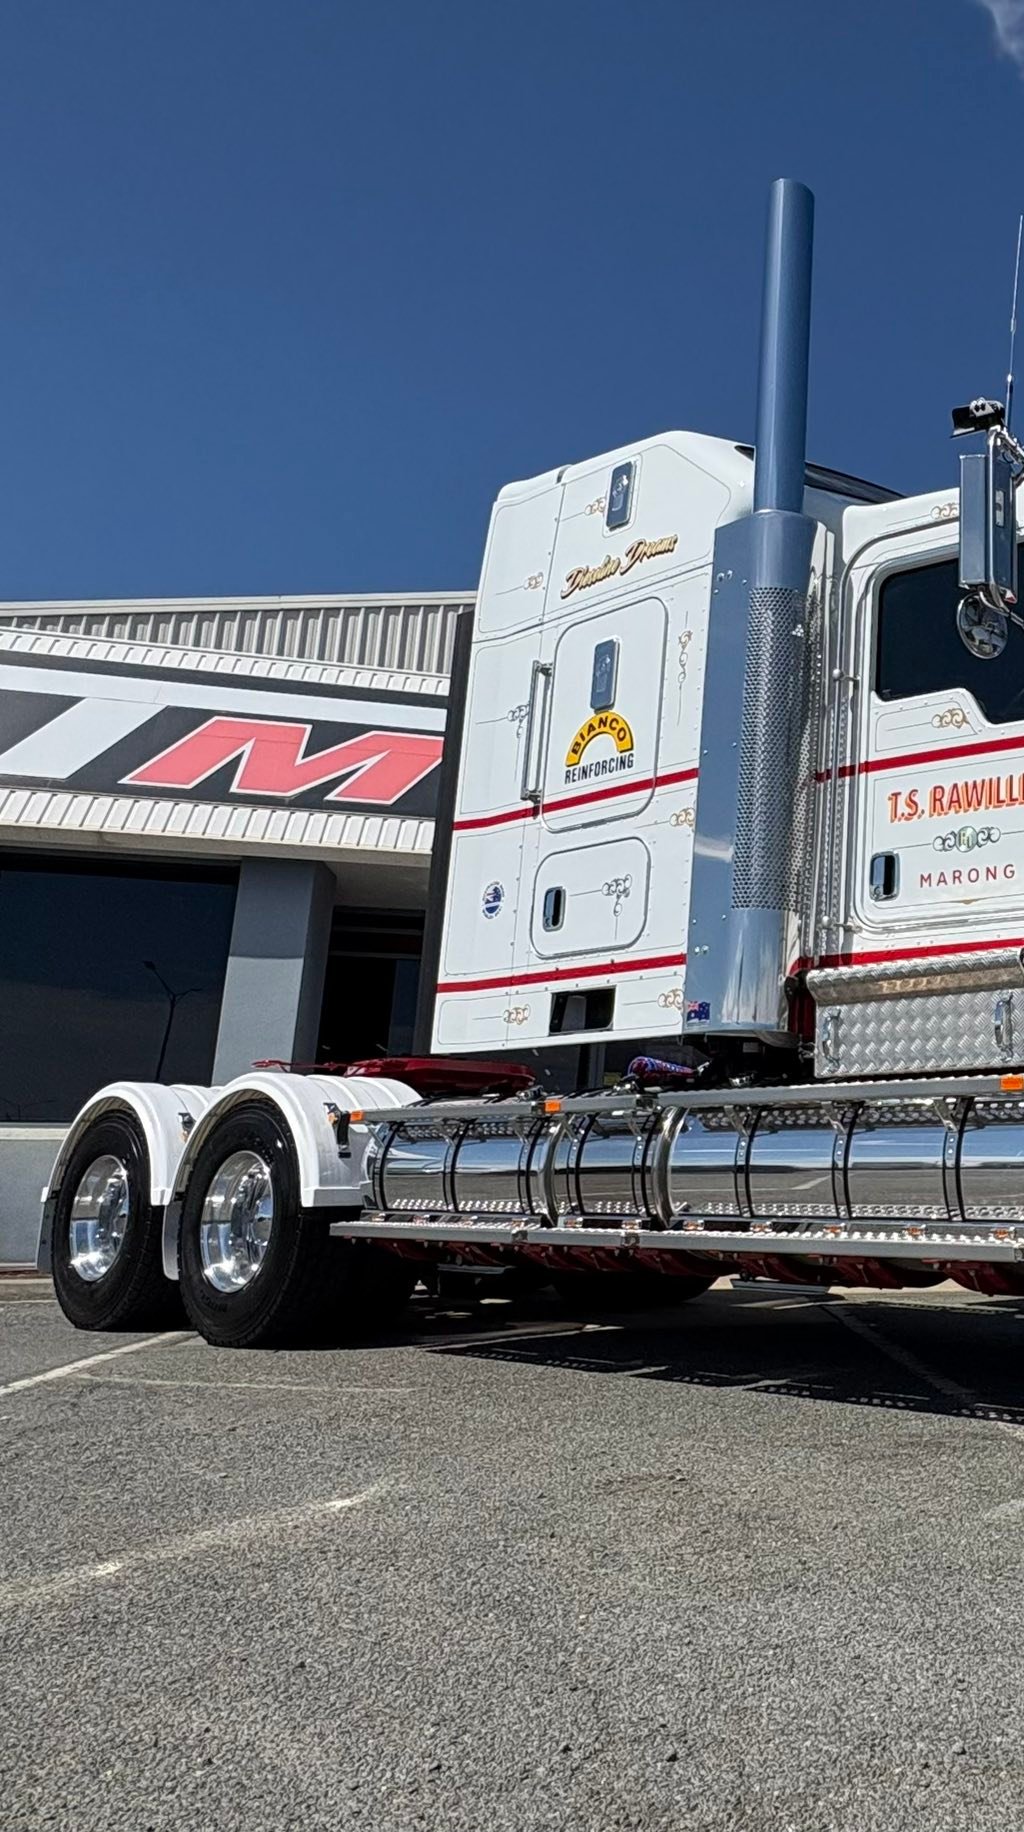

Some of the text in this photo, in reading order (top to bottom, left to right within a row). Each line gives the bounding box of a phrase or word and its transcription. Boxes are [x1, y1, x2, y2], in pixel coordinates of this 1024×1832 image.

[570, 716, 627, 756] BIANCO
[564, 753, 634, 785] REINFORCING
[887, 788, 925, 823] T.S.
[919, 864, 1016, 888] MARONG
